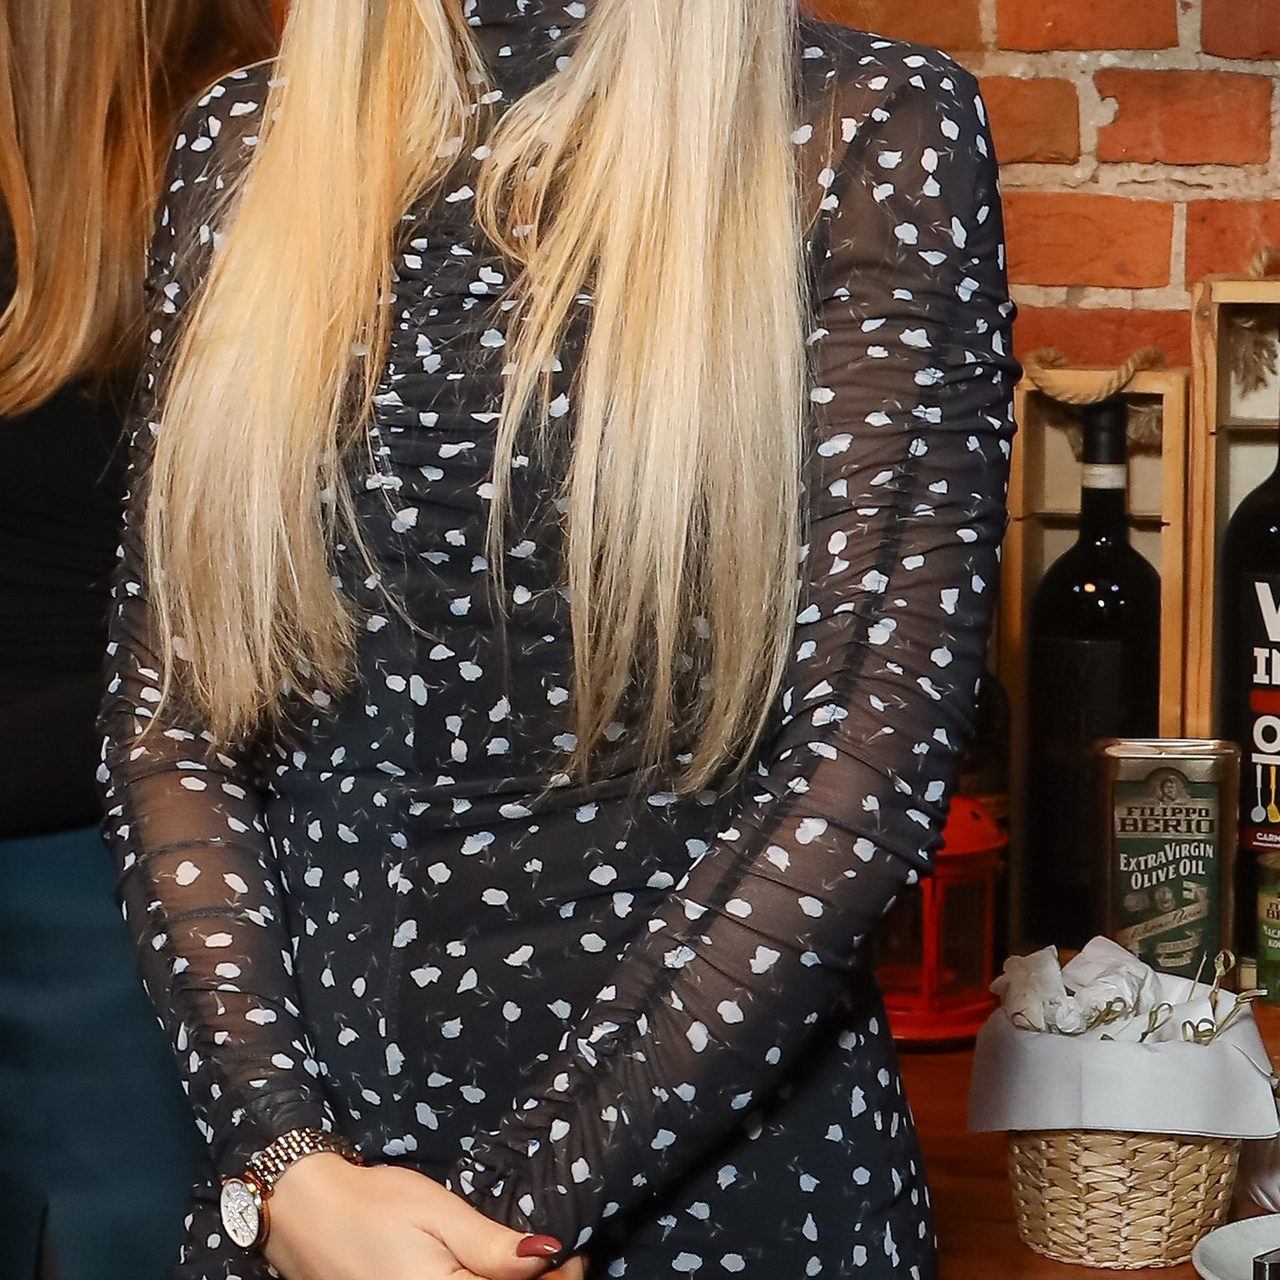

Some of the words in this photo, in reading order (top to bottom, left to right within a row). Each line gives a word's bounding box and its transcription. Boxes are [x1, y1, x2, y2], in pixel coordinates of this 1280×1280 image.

[1126, 806, 1210, 818] FILIPPO
[1118, 818, 1216, 834] BERIO
[1131, 864, 1177, 890] OLIVE
[1179, 859, 1206, 876] OIL
